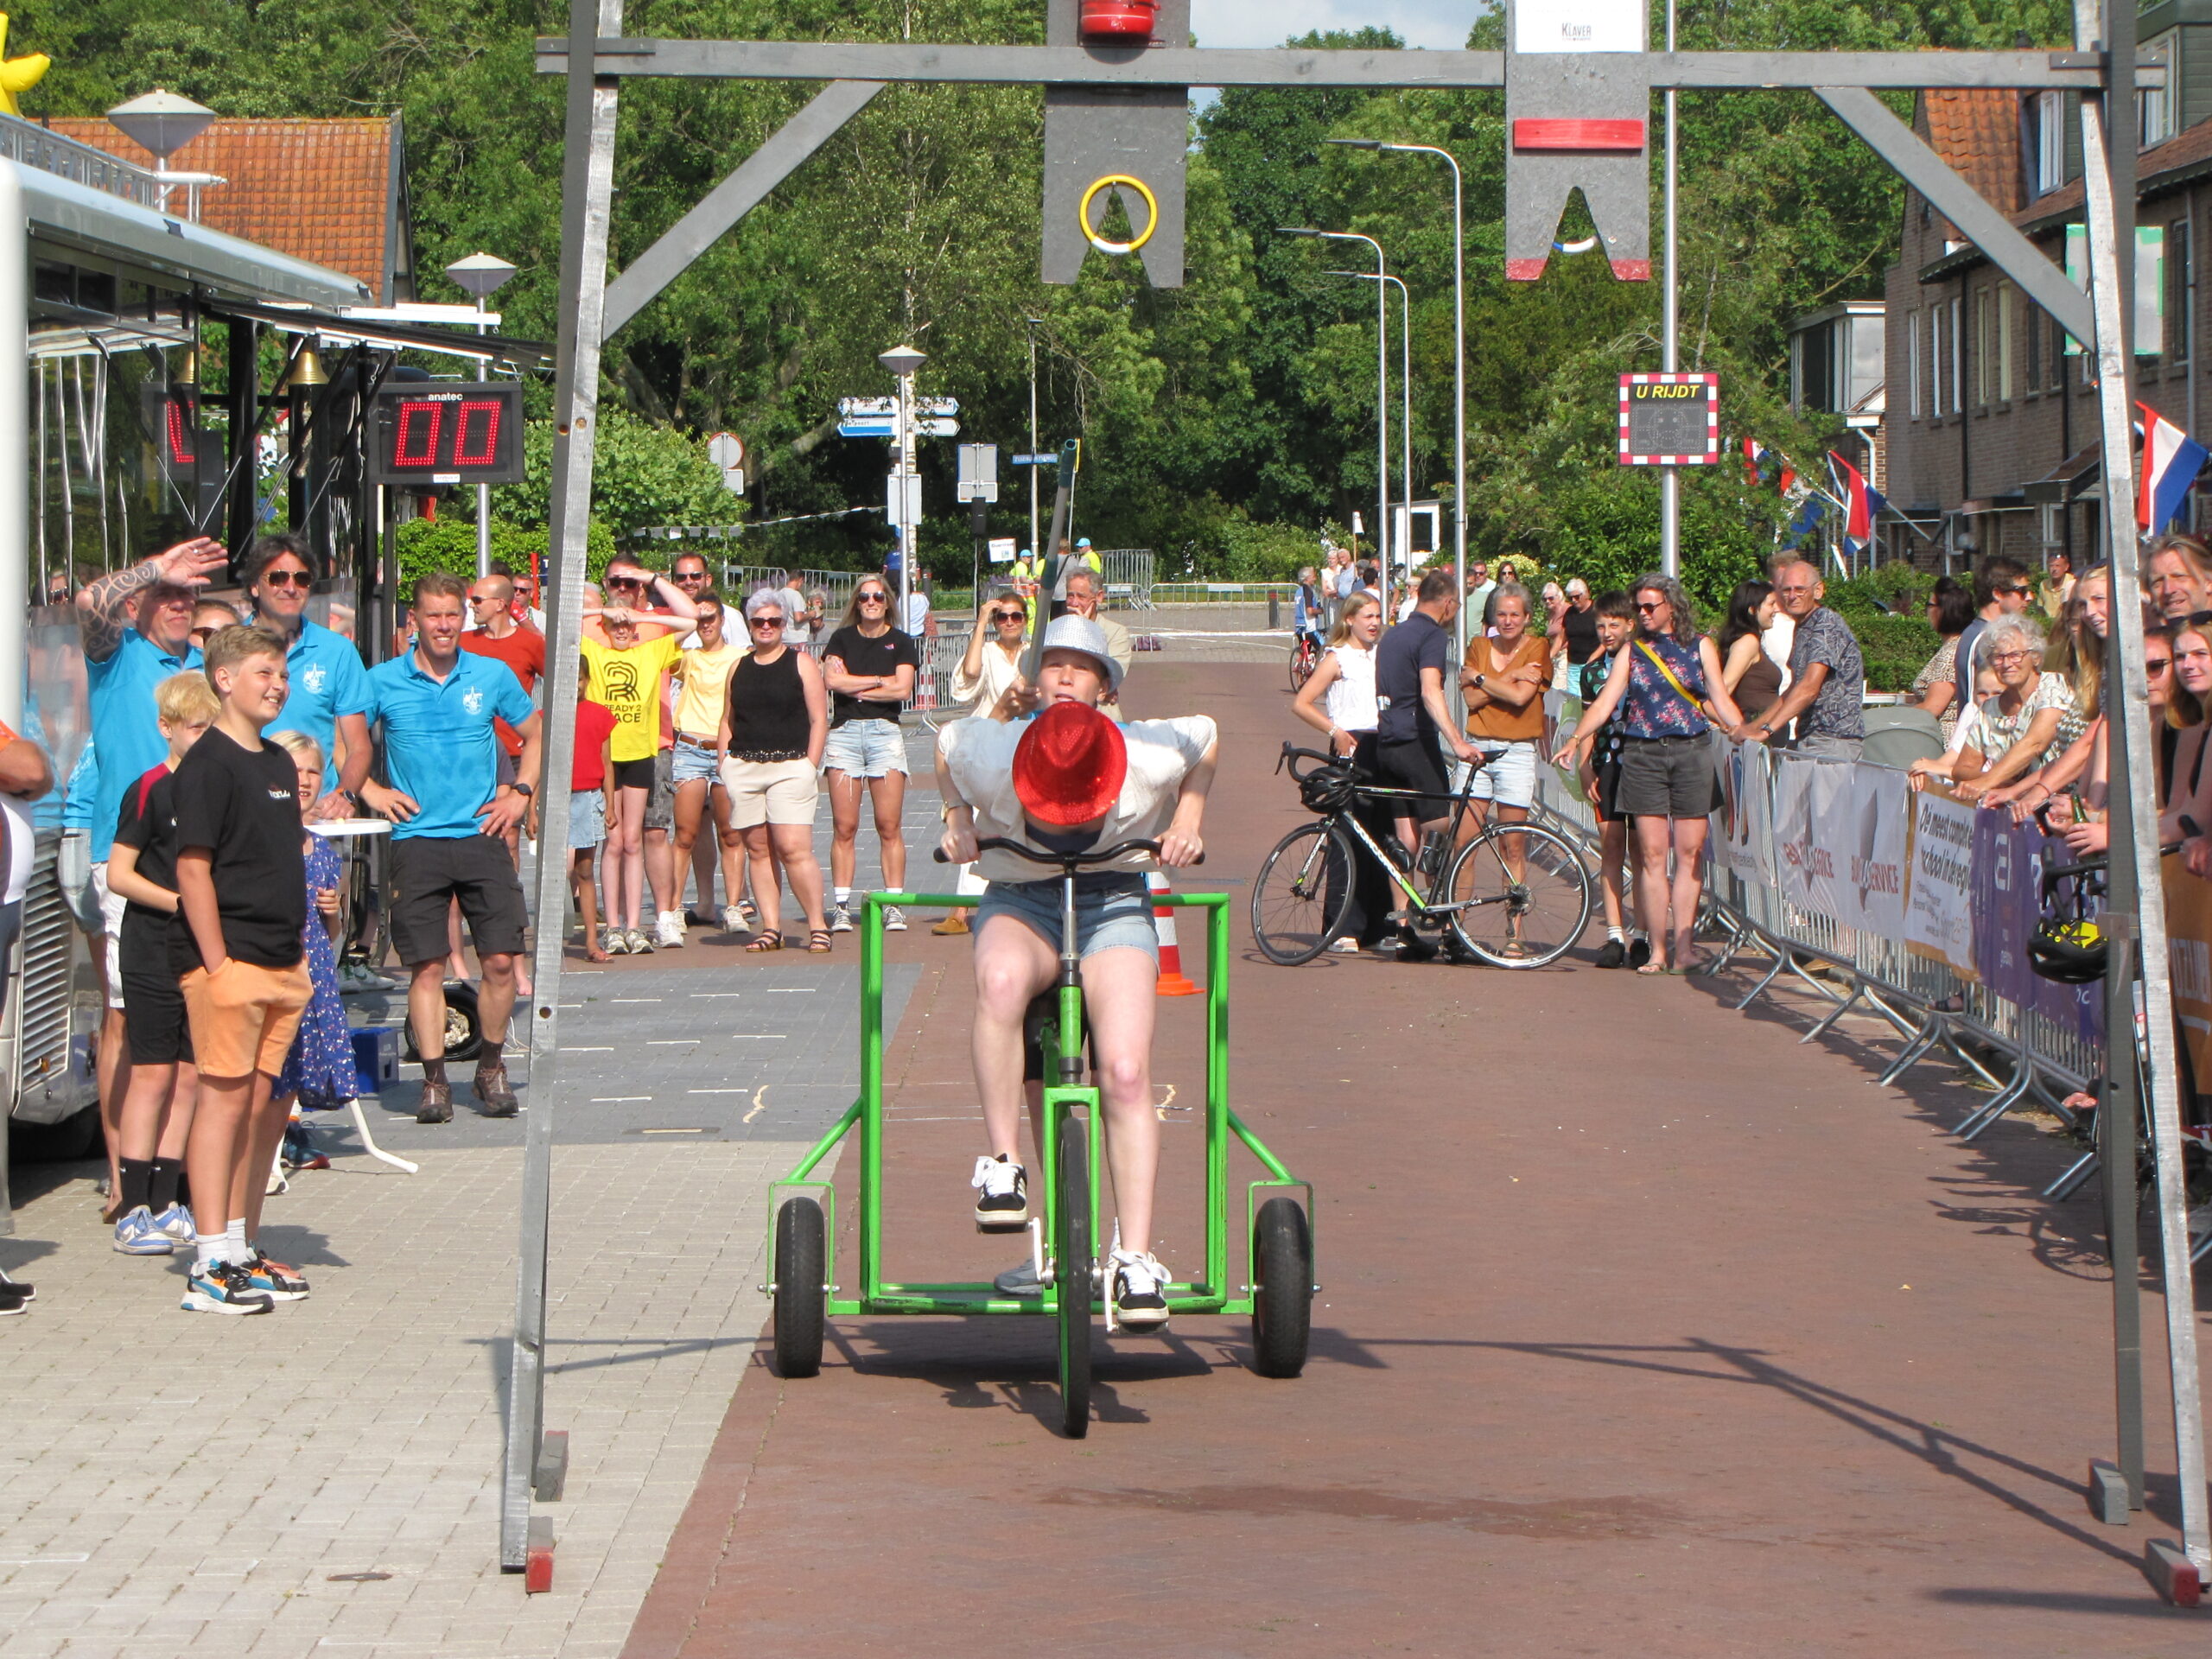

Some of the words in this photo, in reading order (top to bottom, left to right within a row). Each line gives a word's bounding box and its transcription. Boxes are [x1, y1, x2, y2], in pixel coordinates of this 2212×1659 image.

[1561, 22, 1592, 37] KLAVER
[428, 391, 464, 402] anatec
[1636, 385, 1649, 399] U
[1651, 385, 1700, 399] RIJDT
[395, 401, 503, 467] 00
[613, 713, 641, 723] ACE
[1353, 820, 1403, 883] CONCORDE
